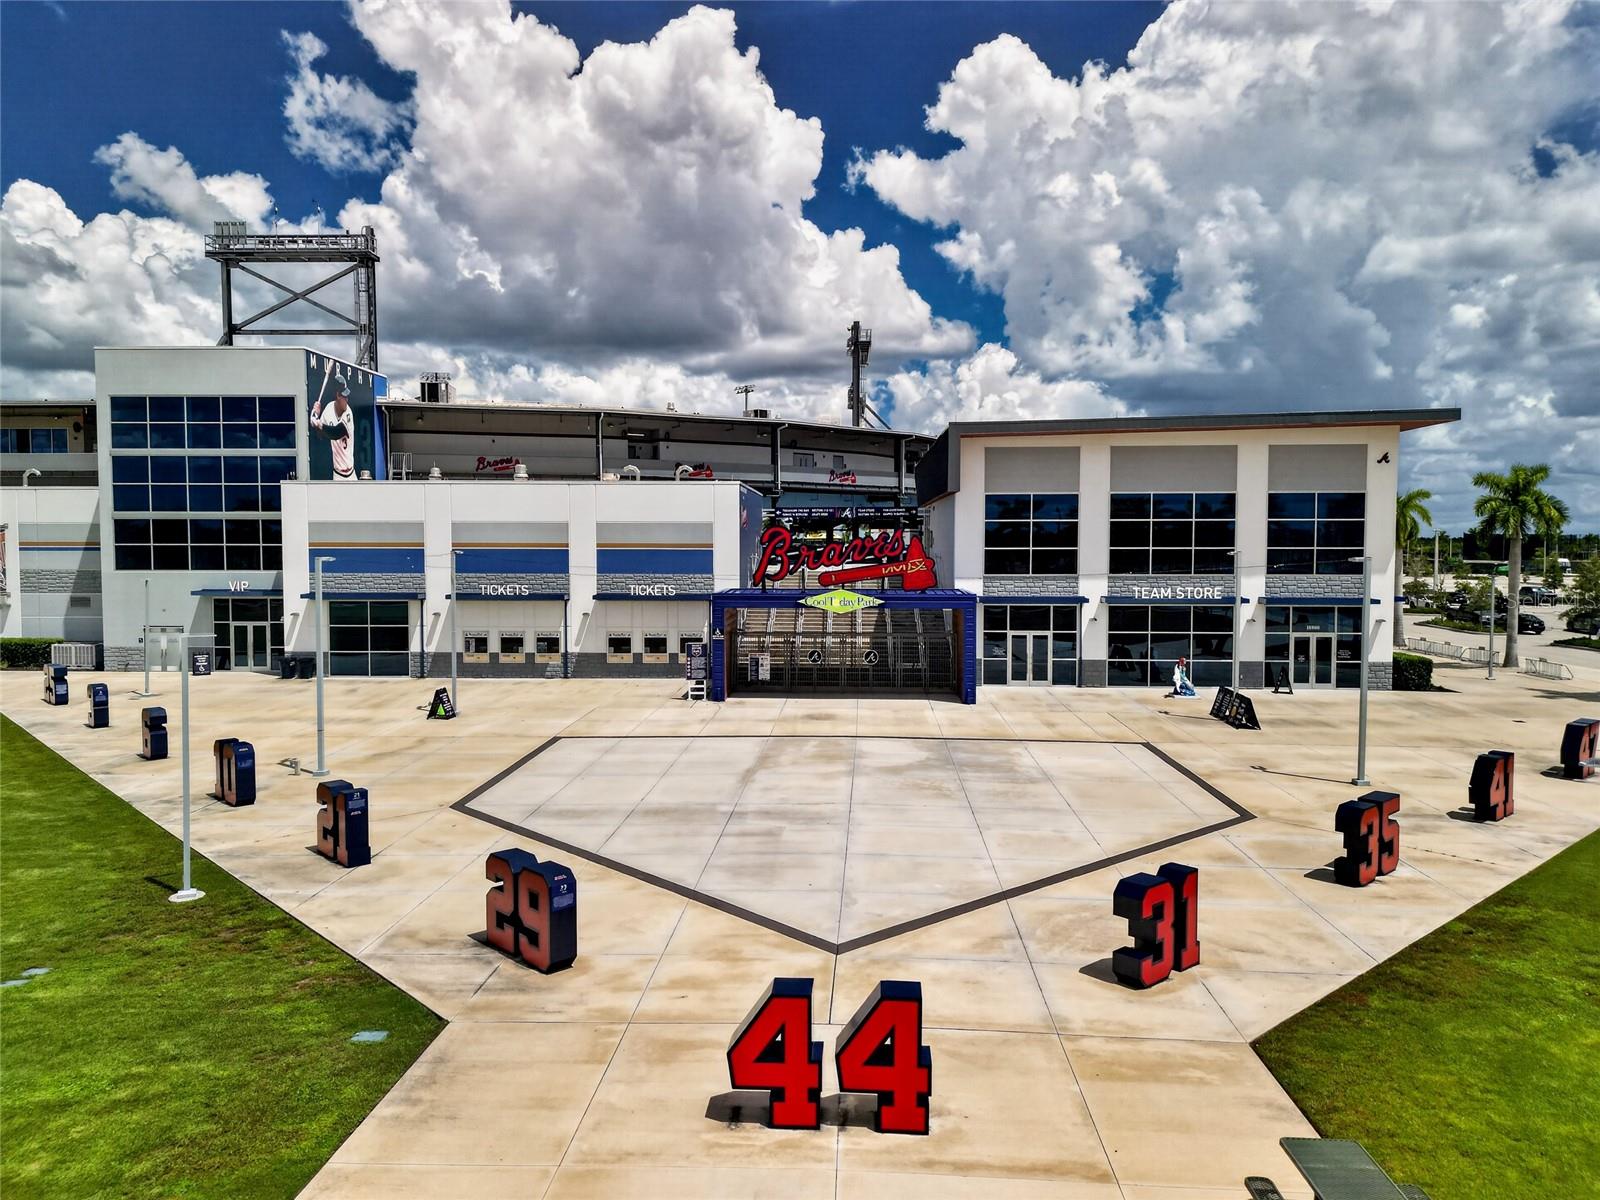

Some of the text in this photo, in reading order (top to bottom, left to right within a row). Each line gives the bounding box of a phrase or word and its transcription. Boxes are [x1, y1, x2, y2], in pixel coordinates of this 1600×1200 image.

[310, 354, 373, 388] MURPHY
[229, 580, 249, 591] VIP
[753, 526, 905, 587] Braves
[479, 584, 529, 595] TICKETS
[629, 585, 676, 596] TICKETS
[857, 596, 879, 606] Park
[1132, 587, 1222, 599] TEAM STORE
[1482, 754, 1514, 820] 41
[316, 781, 358, 868] 21
[1350, 795, 1400, 886] 35
[486, 850, 558, 975] 29
[1132, 867, 1199, 987] 31
[727, 978, 932, 1135] 44
